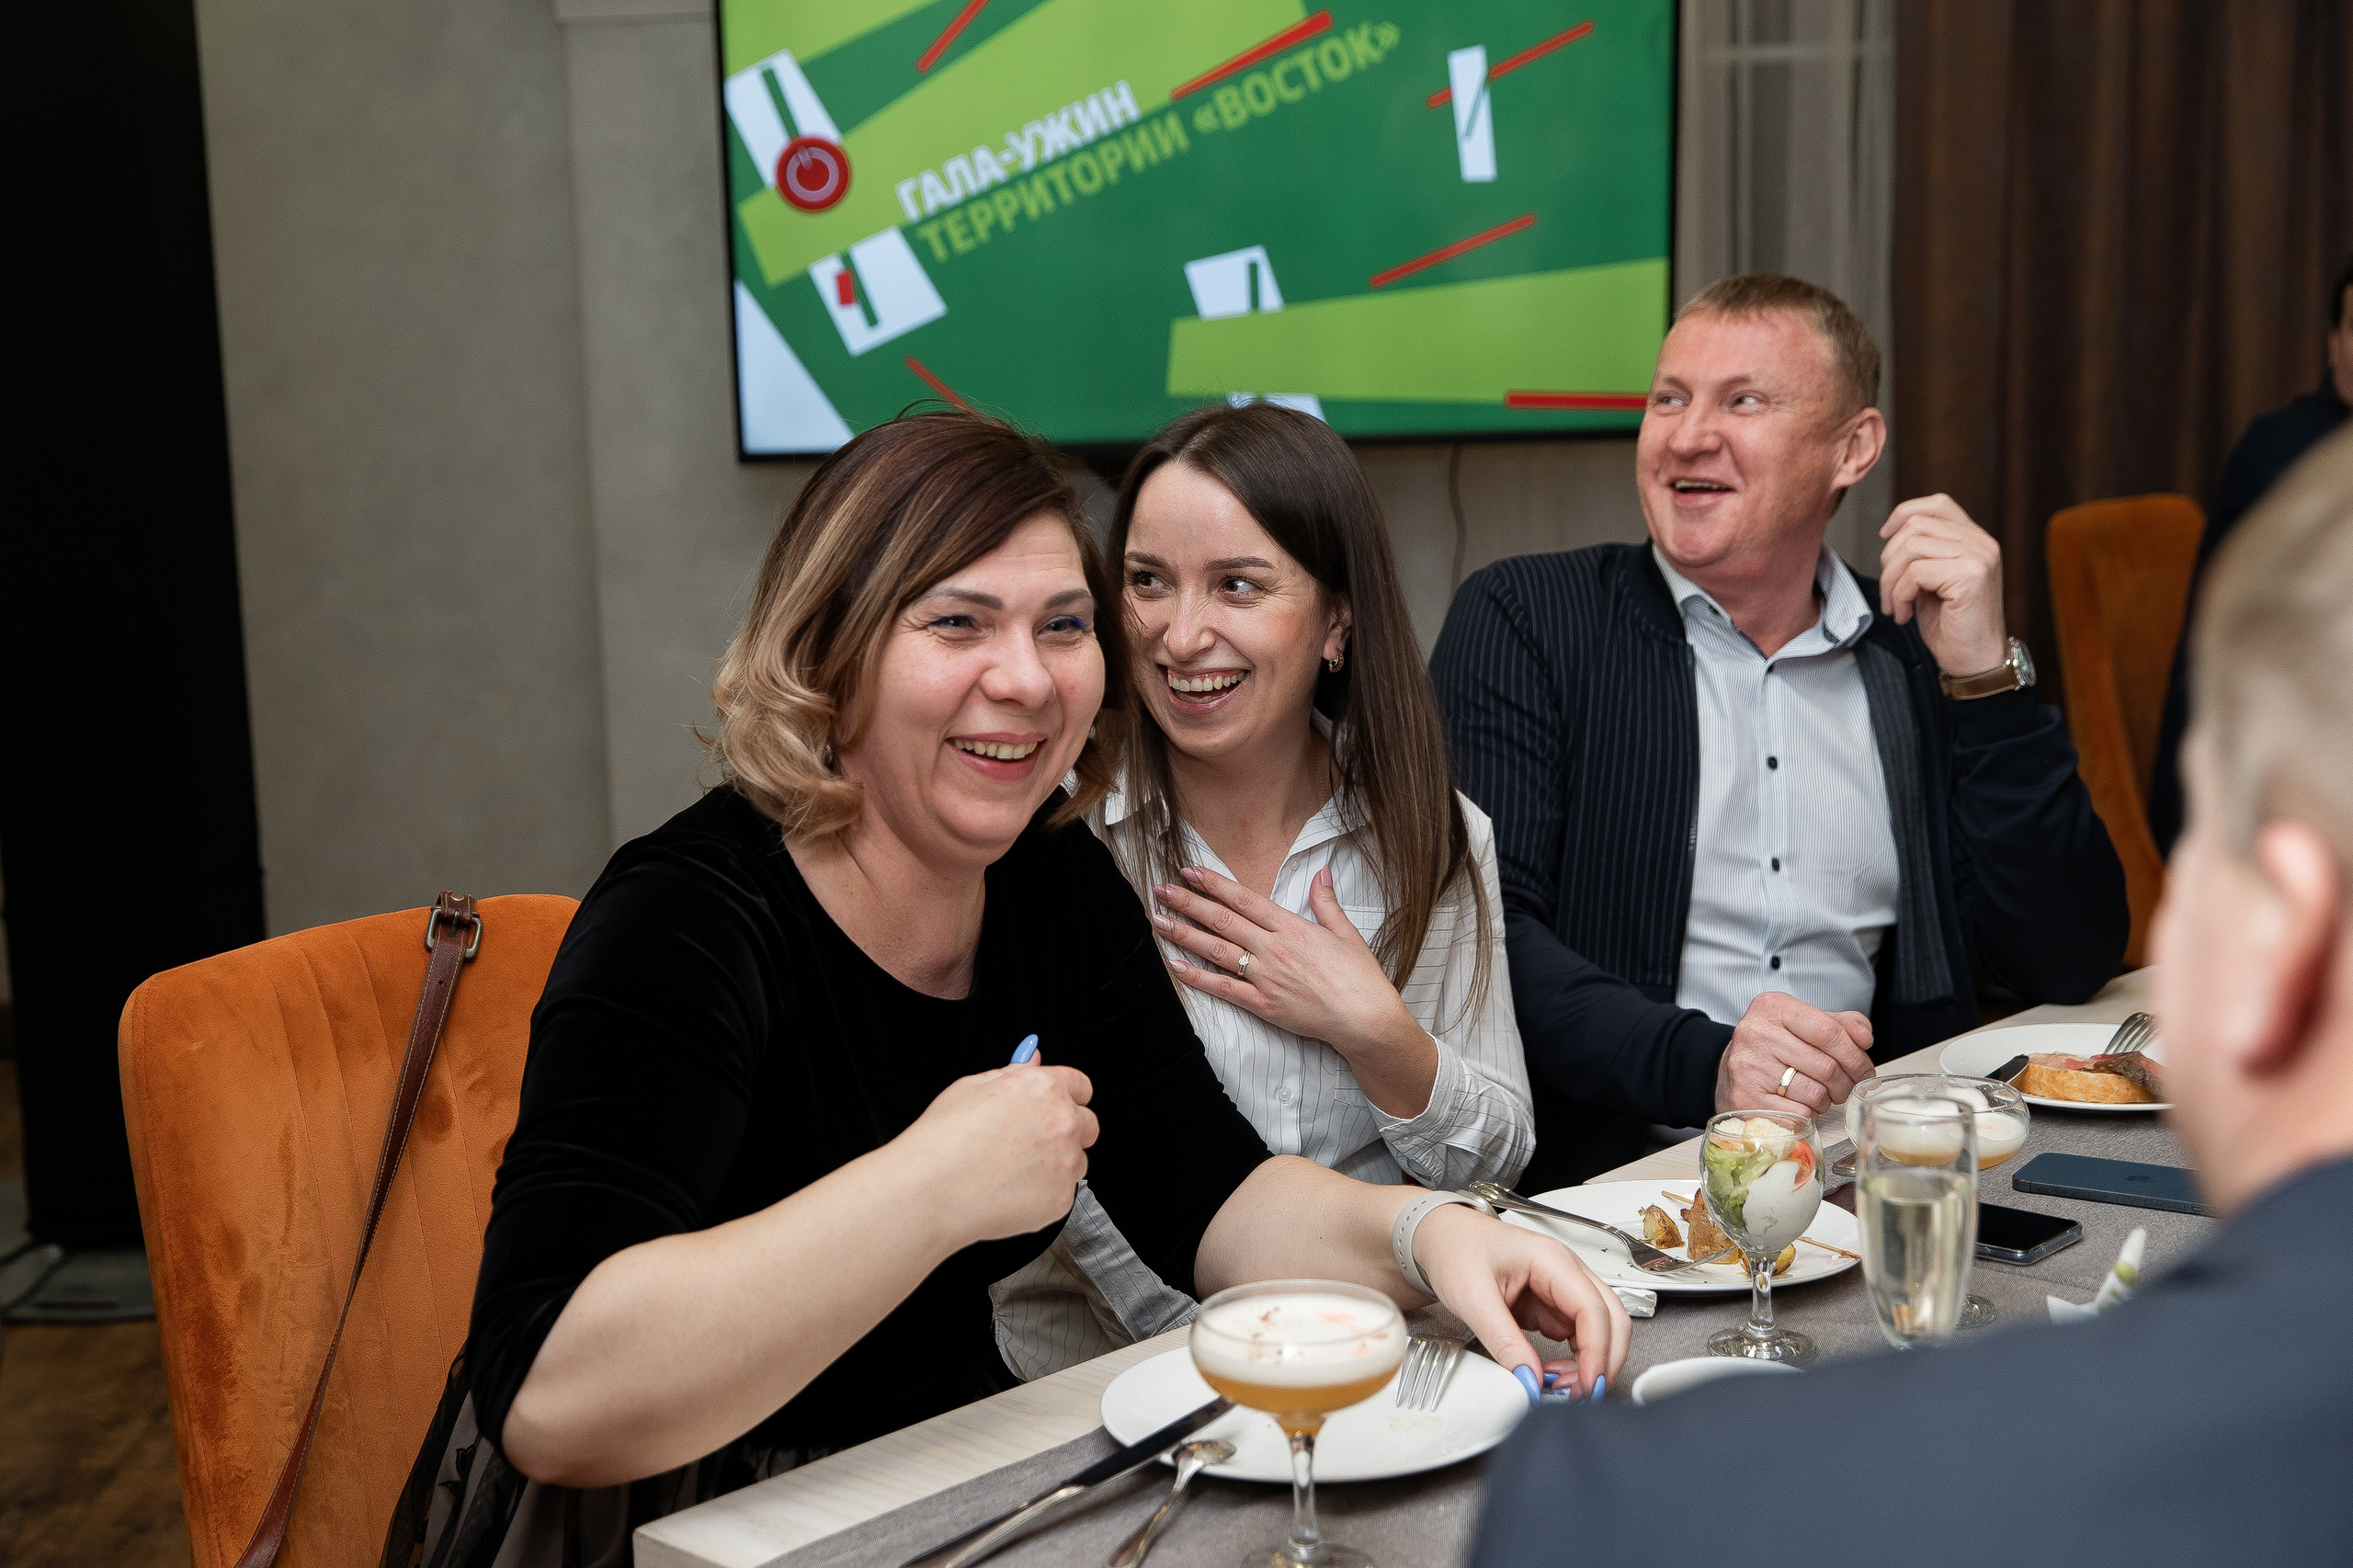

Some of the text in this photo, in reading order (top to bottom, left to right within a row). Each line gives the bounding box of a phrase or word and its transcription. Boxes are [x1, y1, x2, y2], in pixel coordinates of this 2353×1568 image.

[895, 79, 1141, 222] ГАЛА-УЖИН
[917, 21, 1400, 262] ТЕРРИТОРИИ «ВОСТОК»
